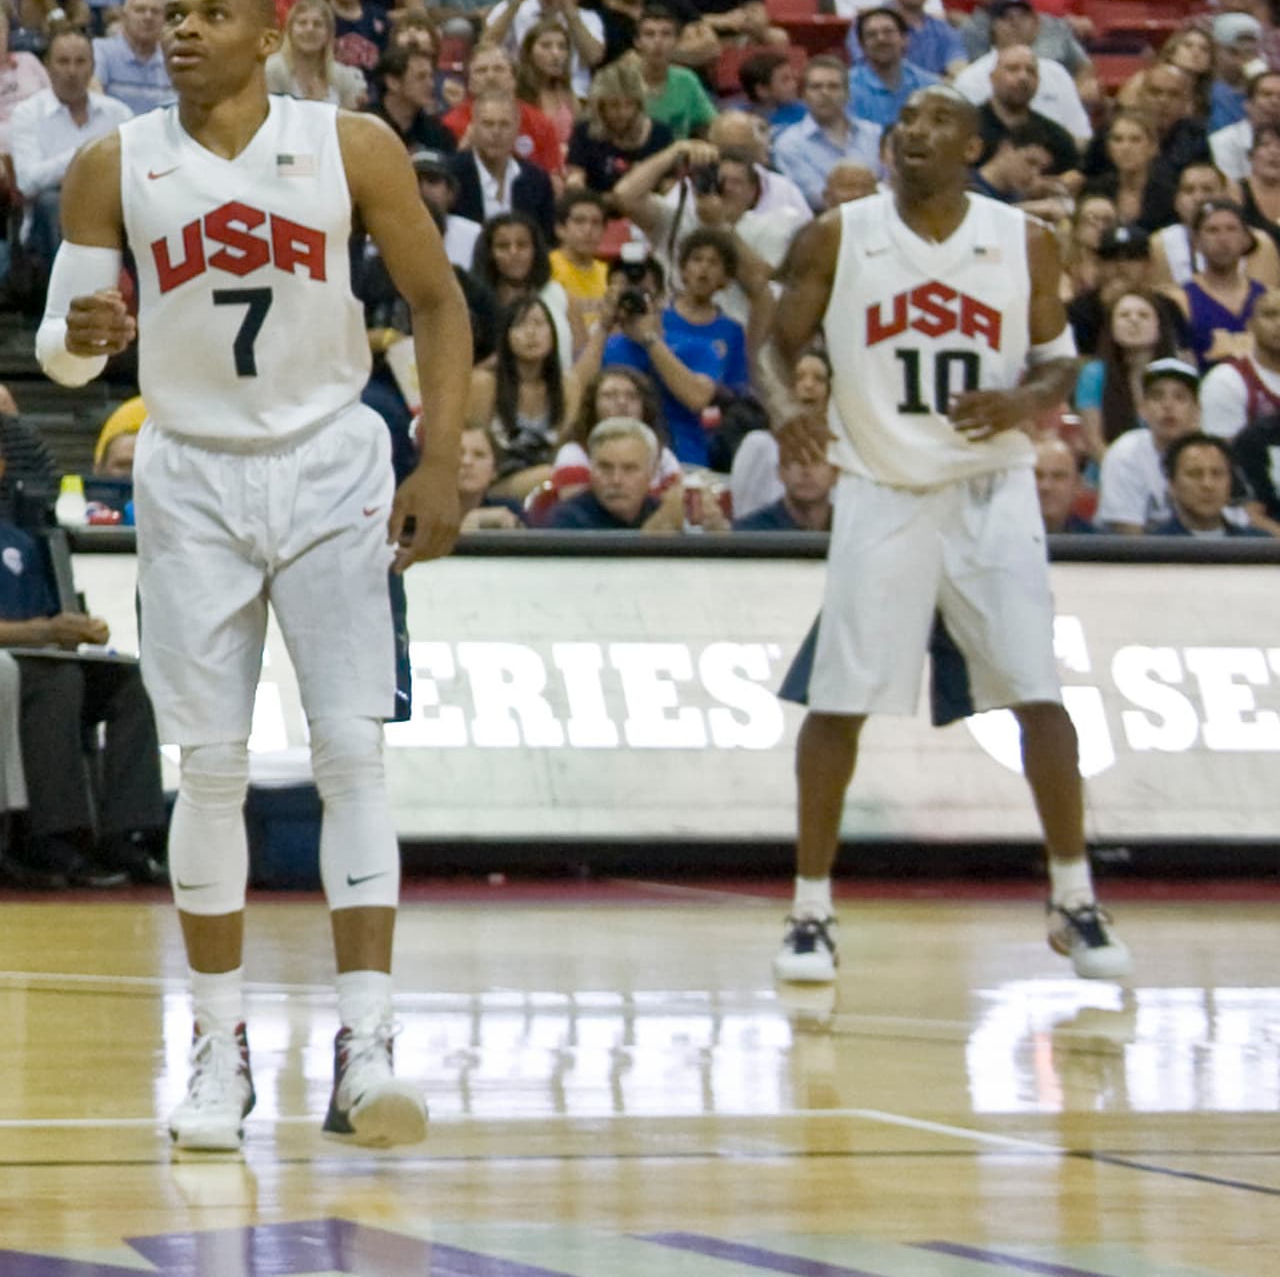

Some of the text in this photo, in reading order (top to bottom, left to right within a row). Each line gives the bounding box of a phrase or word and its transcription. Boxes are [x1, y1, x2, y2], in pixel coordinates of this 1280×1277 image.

[150, 199, 328, 296] USA
[211, 285, 274, 379] 7
[865, 280, 1003, 354] USA
[895, 346, 980, 416] 10
[384, 641, 785, 750] ERIES
[1111, 644, 1280, 752] SE
